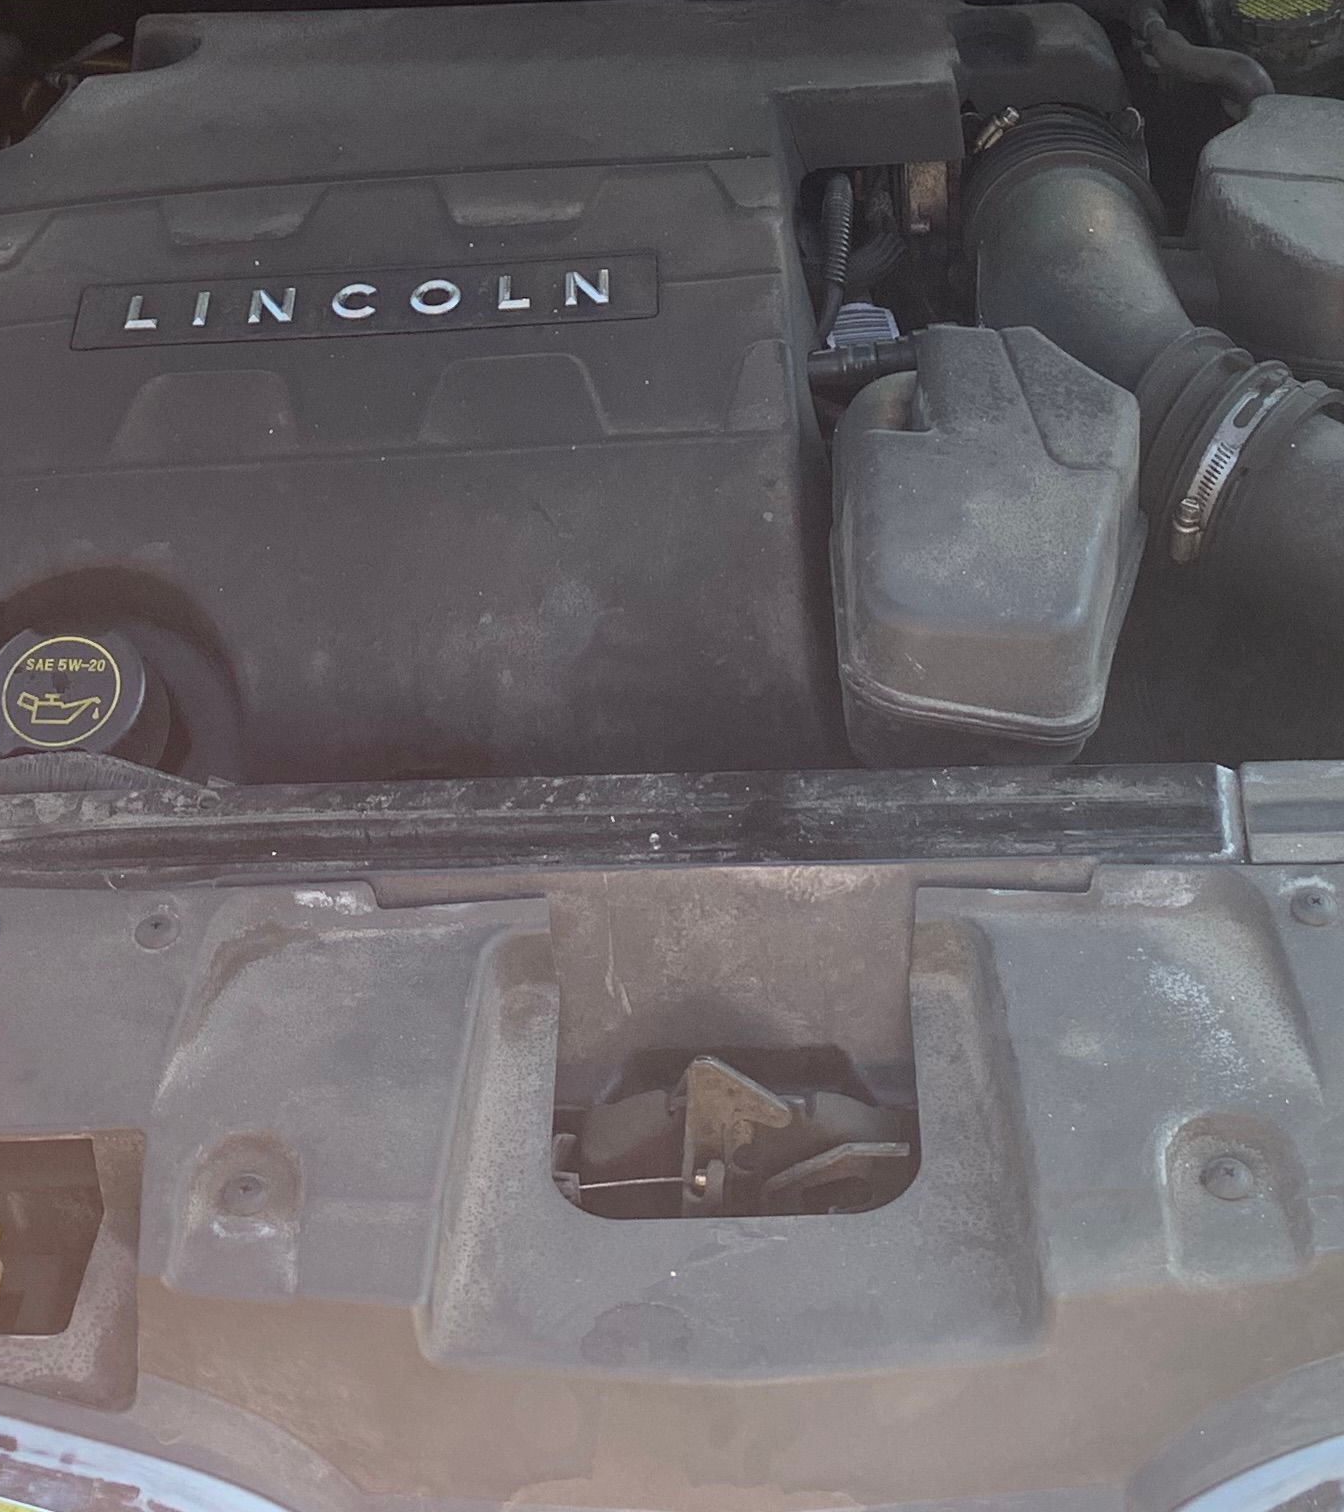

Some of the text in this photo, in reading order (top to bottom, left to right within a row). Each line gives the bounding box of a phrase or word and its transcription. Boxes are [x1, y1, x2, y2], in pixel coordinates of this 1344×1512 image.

[125, 269, 610, 329] LINCOLN
[26, 659, 106, 672] SAE 5W-20
